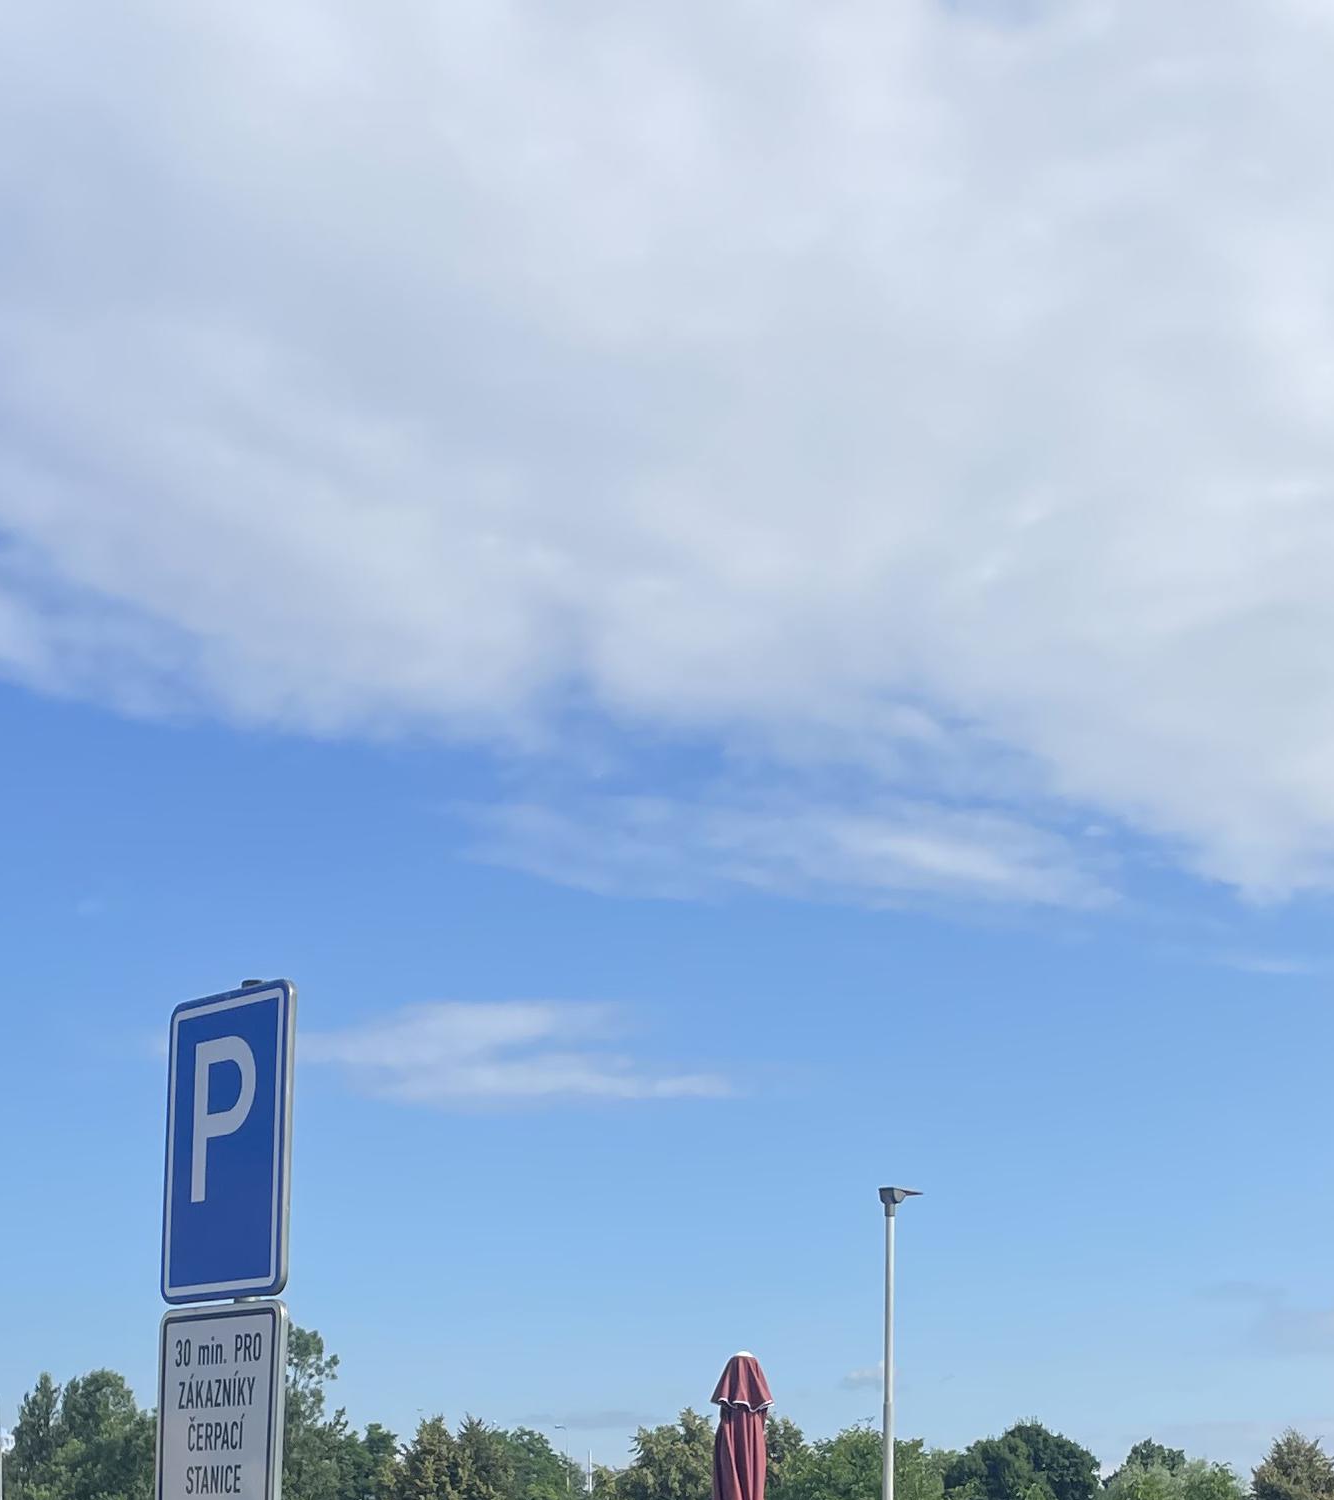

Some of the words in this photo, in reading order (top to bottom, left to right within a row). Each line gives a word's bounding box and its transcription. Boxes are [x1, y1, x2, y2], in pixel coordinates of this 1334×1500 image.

[190, 1035, 257, 1203] P
[175, 1338, 191, 1367] 30
[197, 1336, 227, 1366] min.
[234, 1332, 262, 1363] PRO
[178, 1370, 256, 1410] ZÁKAZNÍKY
[187, 1413, 245, 1451] ČERPACÍ
[185, 1464, 242, 1495] STANICE
